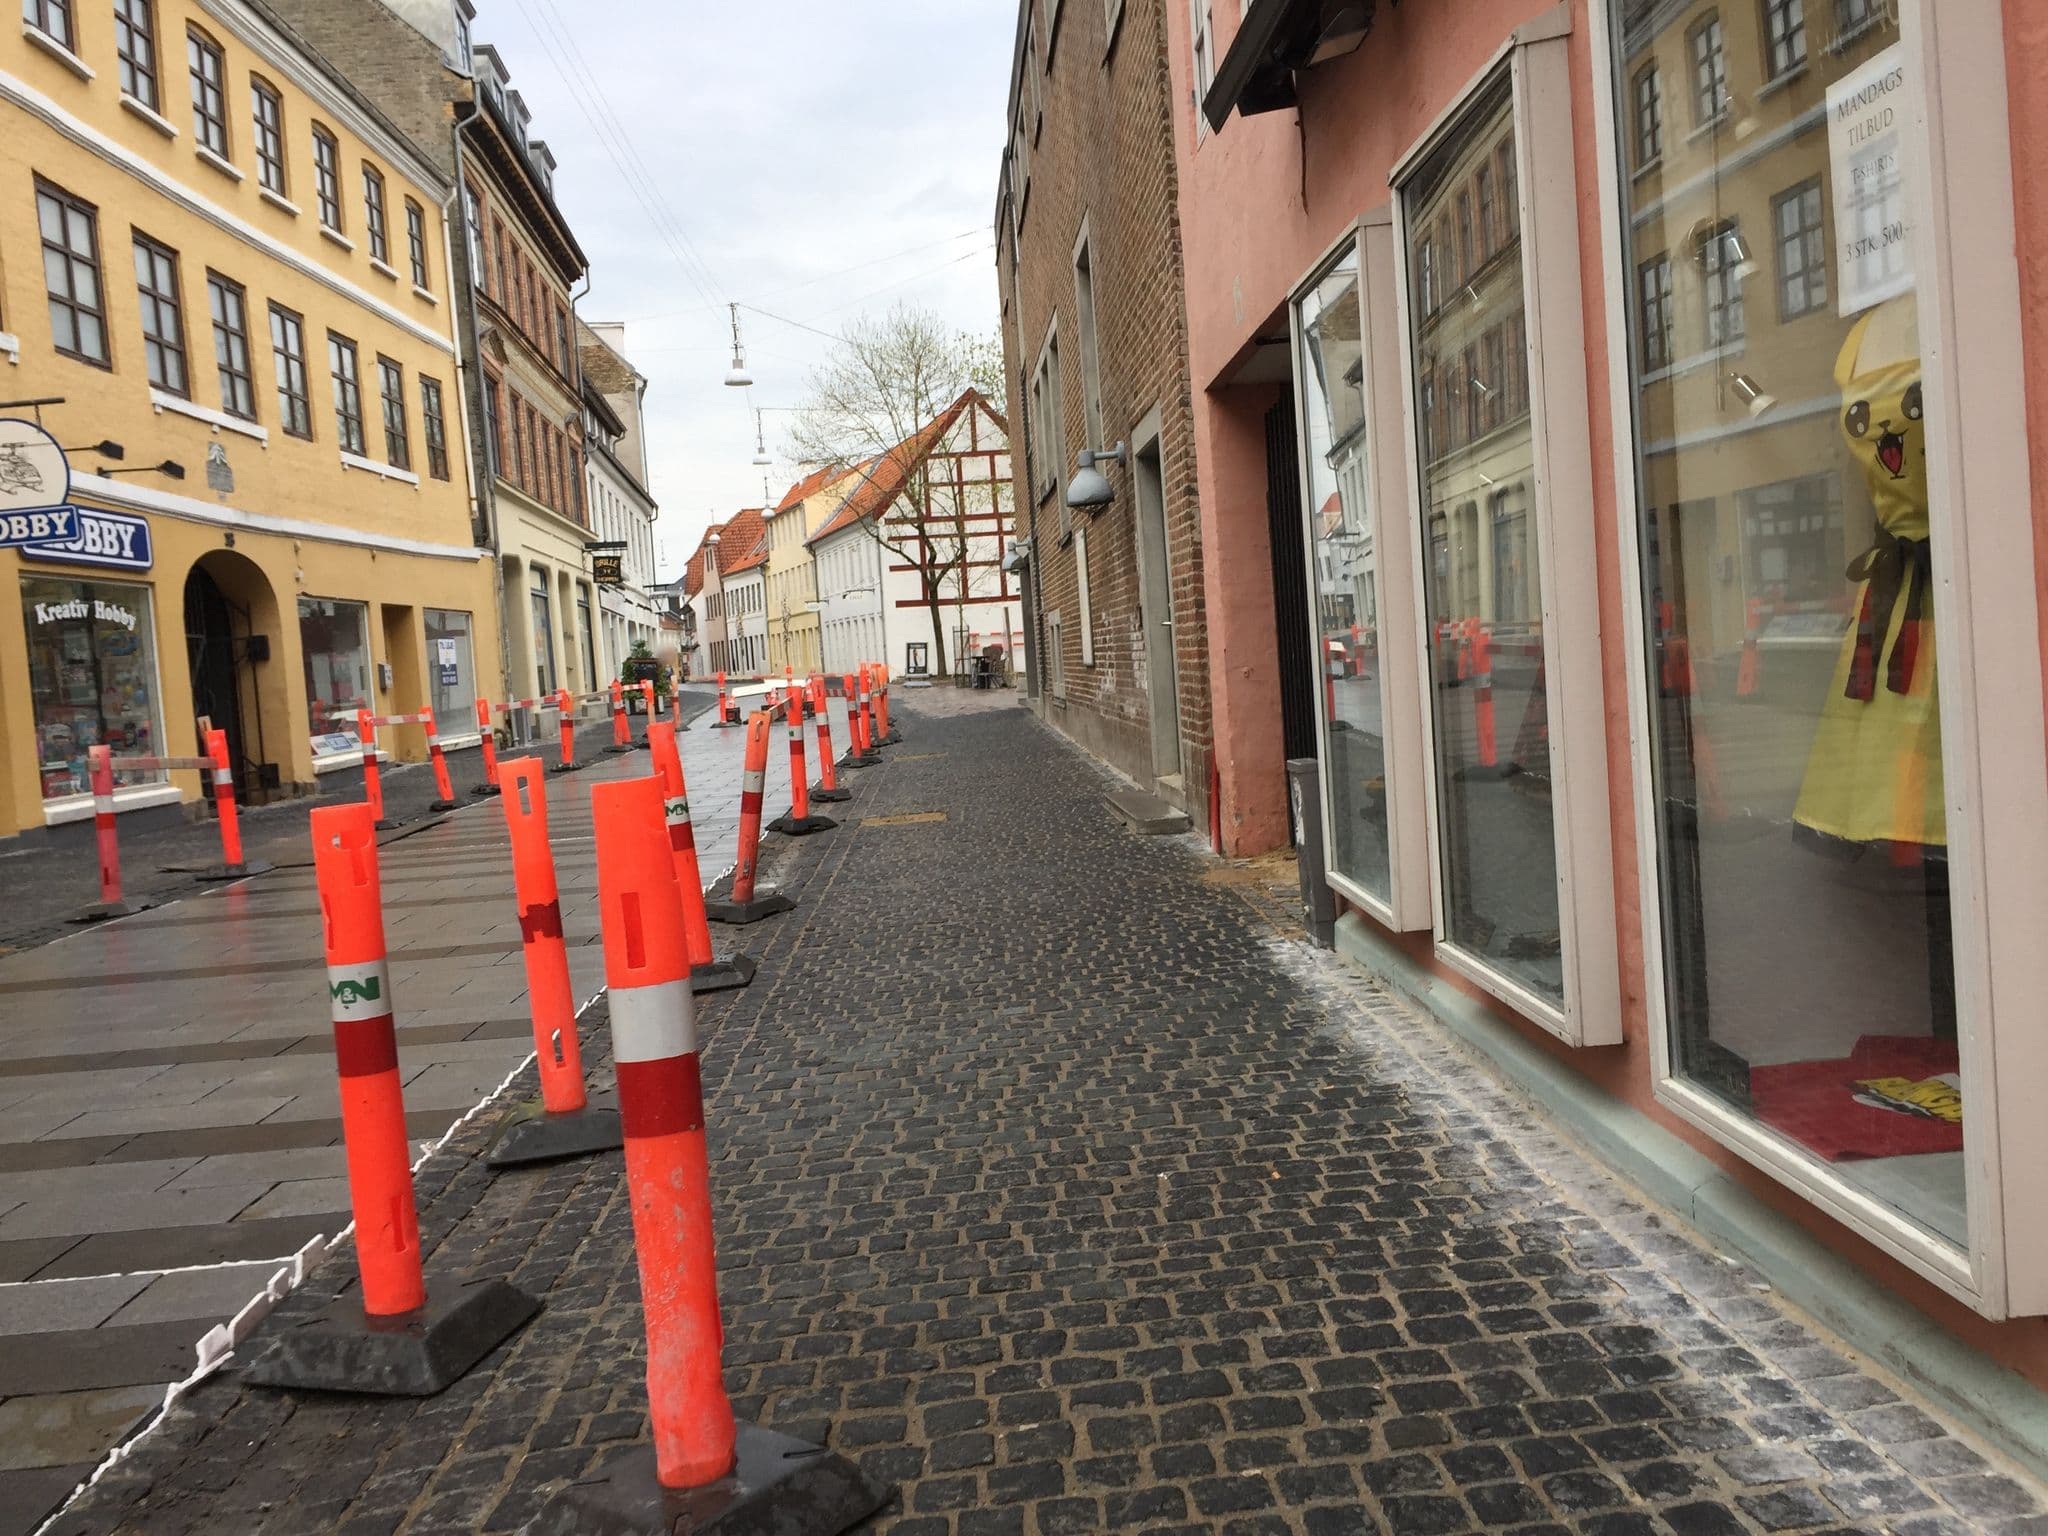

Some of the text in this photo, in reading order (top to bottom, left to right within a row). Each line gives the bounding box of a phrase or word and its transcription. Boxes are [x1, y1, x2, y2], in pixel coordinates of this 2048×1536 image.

[1837, 67, 1903, 122] MANDAGS
[1848, 107, 1894, 146] TILBUD
[1850, 153, 1894, 185] T-SHIRTS
[1846, 243, 1853, 263] 3
[43, 517, 135, 558] BBY
[34, 599, 136, 631] Kreativ Hobby
